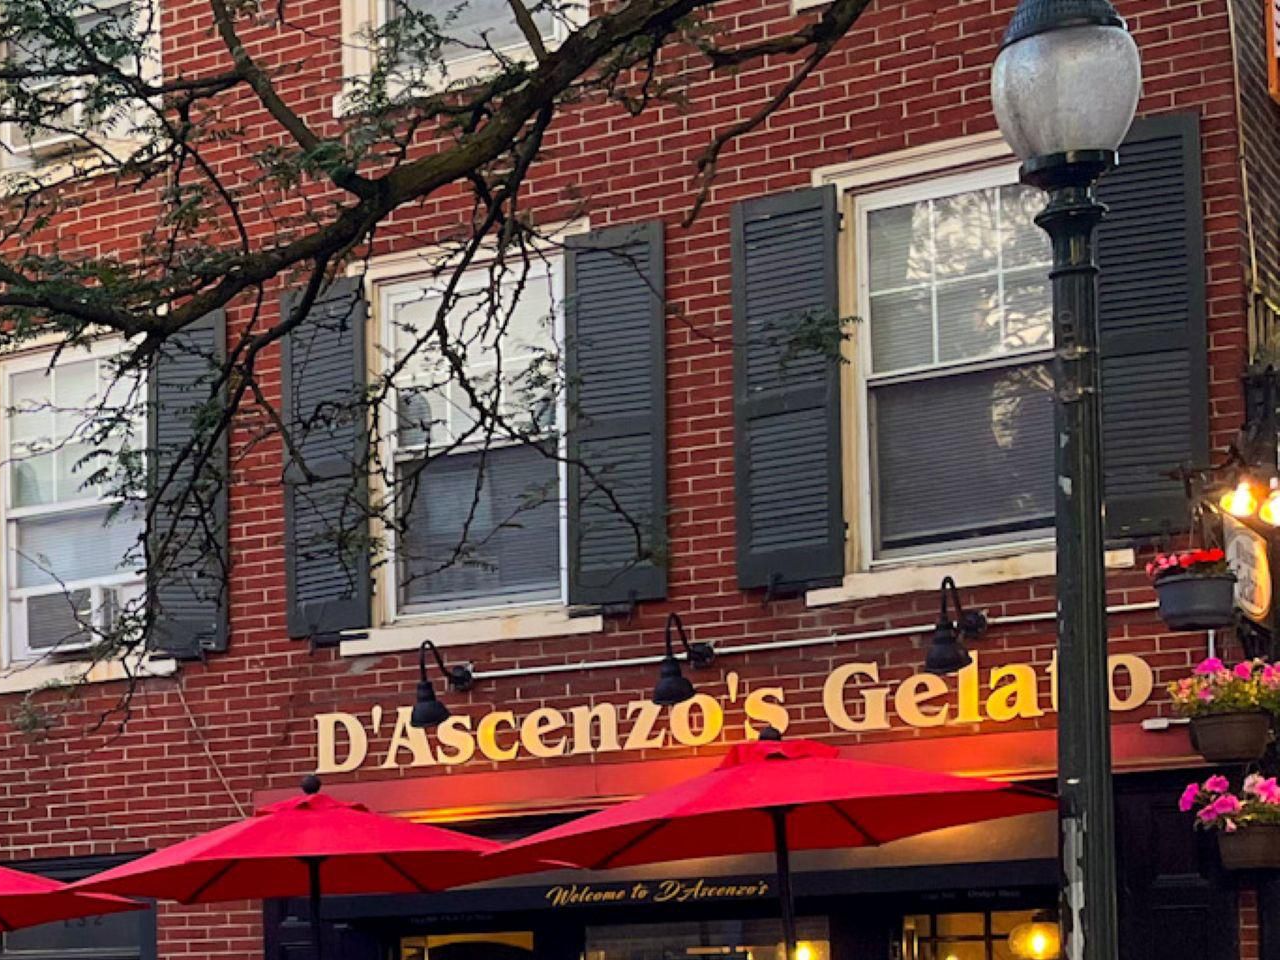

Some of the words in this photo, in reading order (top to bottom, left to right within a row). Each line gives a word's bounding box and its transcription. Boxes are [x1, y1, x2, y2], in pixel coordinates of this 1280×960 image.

[314, 671, 789, 773] D'Ascenzo's
[544, 884, 626, 907] Welcome
[630, 883, 649, 900] to
[652, 878, 769, 902] D'Ascenzo's
